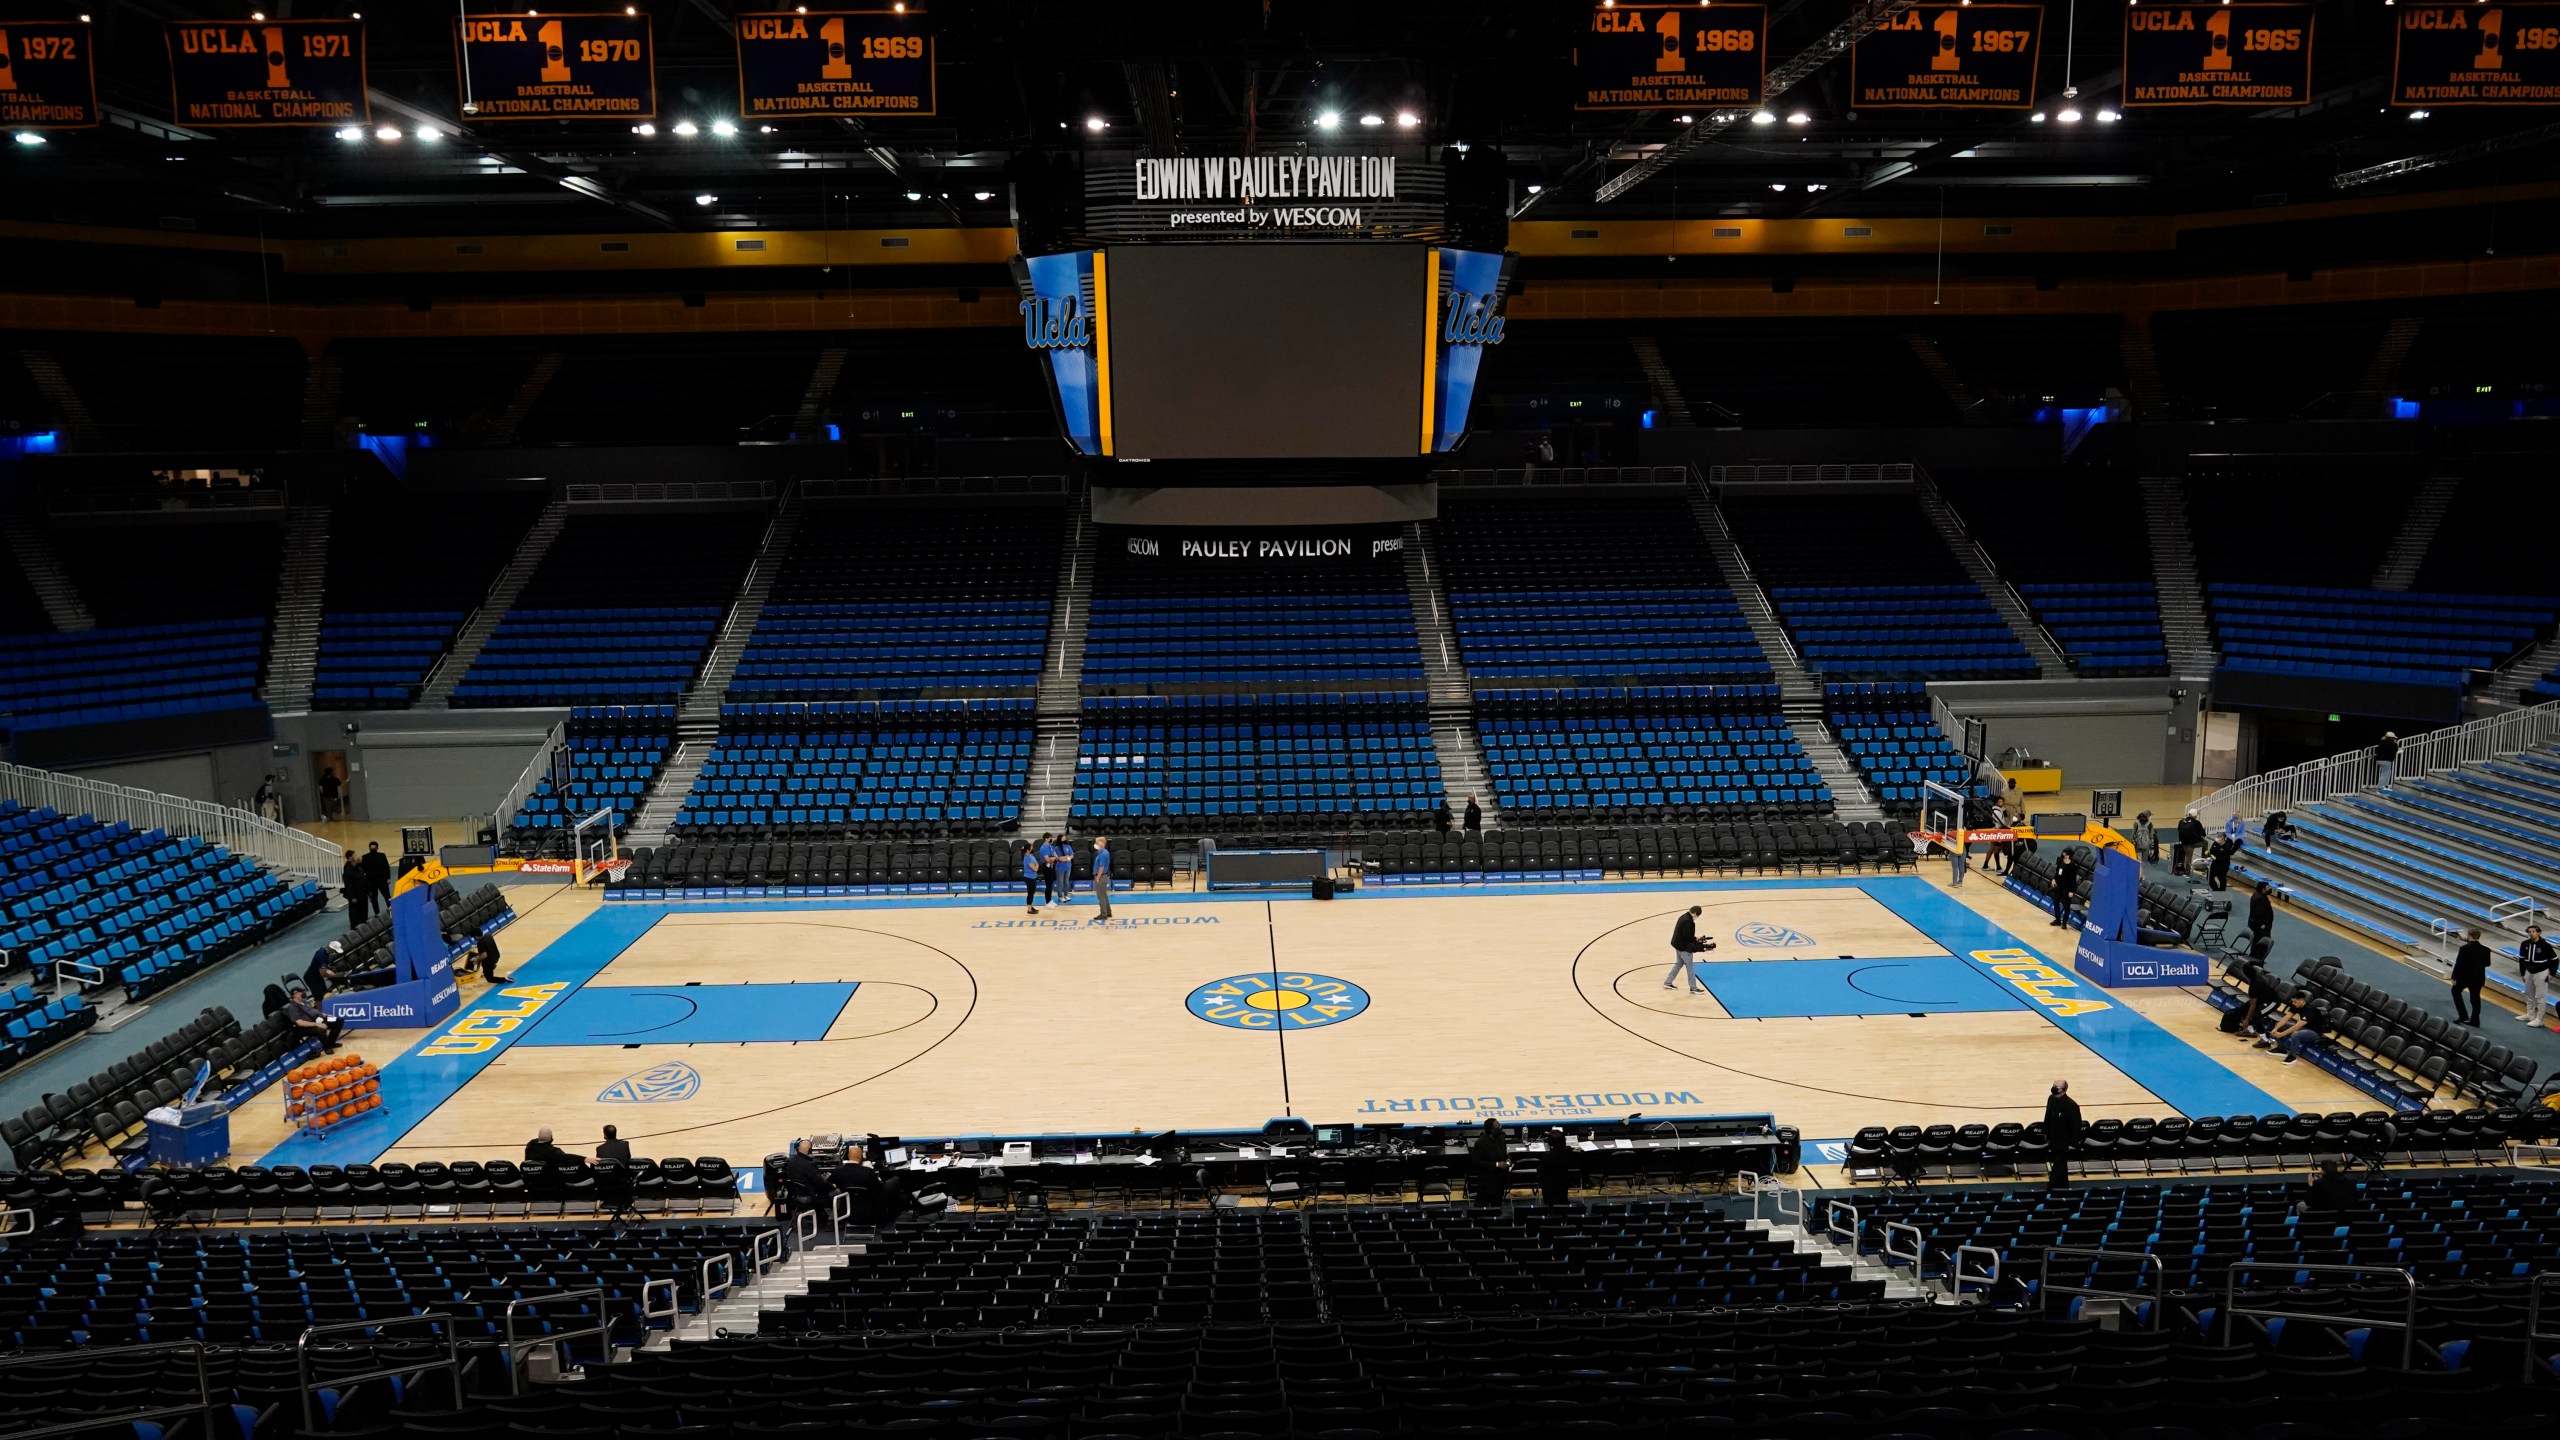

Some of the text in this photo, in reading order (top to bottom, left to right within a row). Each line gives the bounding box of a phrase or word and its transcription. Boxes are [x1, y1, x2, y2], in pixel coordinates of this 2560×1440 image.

[1591, 11, 1754, 73] CLA 1 1968
[1931, 10, 1964, 71] 1
[1972, 30, 2029, 53] 1967
[2131, 9, 2300, 71] UCLA 1 1965
[2404, 9, 2560, 69] UCLA 1 196
[22, 37, 76, 60] 1972
[459, 20, 641, 82] UCLA 1 1970
[741, 17, 923, 80] UCLA 1 1969
[180, 27, 350, 87] UCLA 1 1971
[1632, 74, 1706, 86] BASKETBALL
[1908, 74, 1980, 85] BASKETBALL
[2178, 72, 2252, 83] BASKETBALL
[2450, 71, 2522, 82] BASKETBALL
[227, 90, 316, 101] BASKETBALL
[517, 84, 594, 96] BASKETBALL
[797, 82, 873, 94] BASKETBALL
[1588, 87, 1750, 103] NATIONAL CHAMPIONS
[1865, 88, 2020, 102] NATIONAL CHAMPIONS
[2135, 85, 2293, 100] NATIONAL CHAMPIONS
[2406, 85, 2479, 99] NATIONAL
[0, 92, 44, 103] TBALL
[472, 97, 640, 113] NATIONAL CHAMPIONS
[754, 95, 919, 111] NATIONAL CHAMPIONS
[2, 105, 83, 121] CHAMPIONS
[190, 102, 353, 119] NATIONAL CHAMPIONS
[1136, 156, 1395, 200] EDWIN W PAULEY PAVILION
[1170, 206, 1361, 228] presented by WESCOM
[1182, 540, 1251, 557] PAULEY
[1259, 539, 1351, 557] PAVILION
[971, 916, 1221, 929] WOODEN COURT
[2085, 920, 2104, 936] READY
[2078, 946, 2101, 966] WESCOM
[430, 958, 448, 975] READY
[2127, 964, 2199, 976] UCLA Health
[1203, 975, 1347, 996] UCLA
[1968, 948, 2113, 1017] UCLA
[431, 985, 454, 1006] WESCOM
[338, 1004, 414, 1018] UCLA Health
[416, 981, 571, 1057] UCLA
[1205, 1004, 1355, 1027] UCLA
[1357, 1091, 1704, 1114] WOODEN COURT
[1475, 1109, 1526, 1118] JOHN
[1542, 1107, 1594, 1115] NELL
